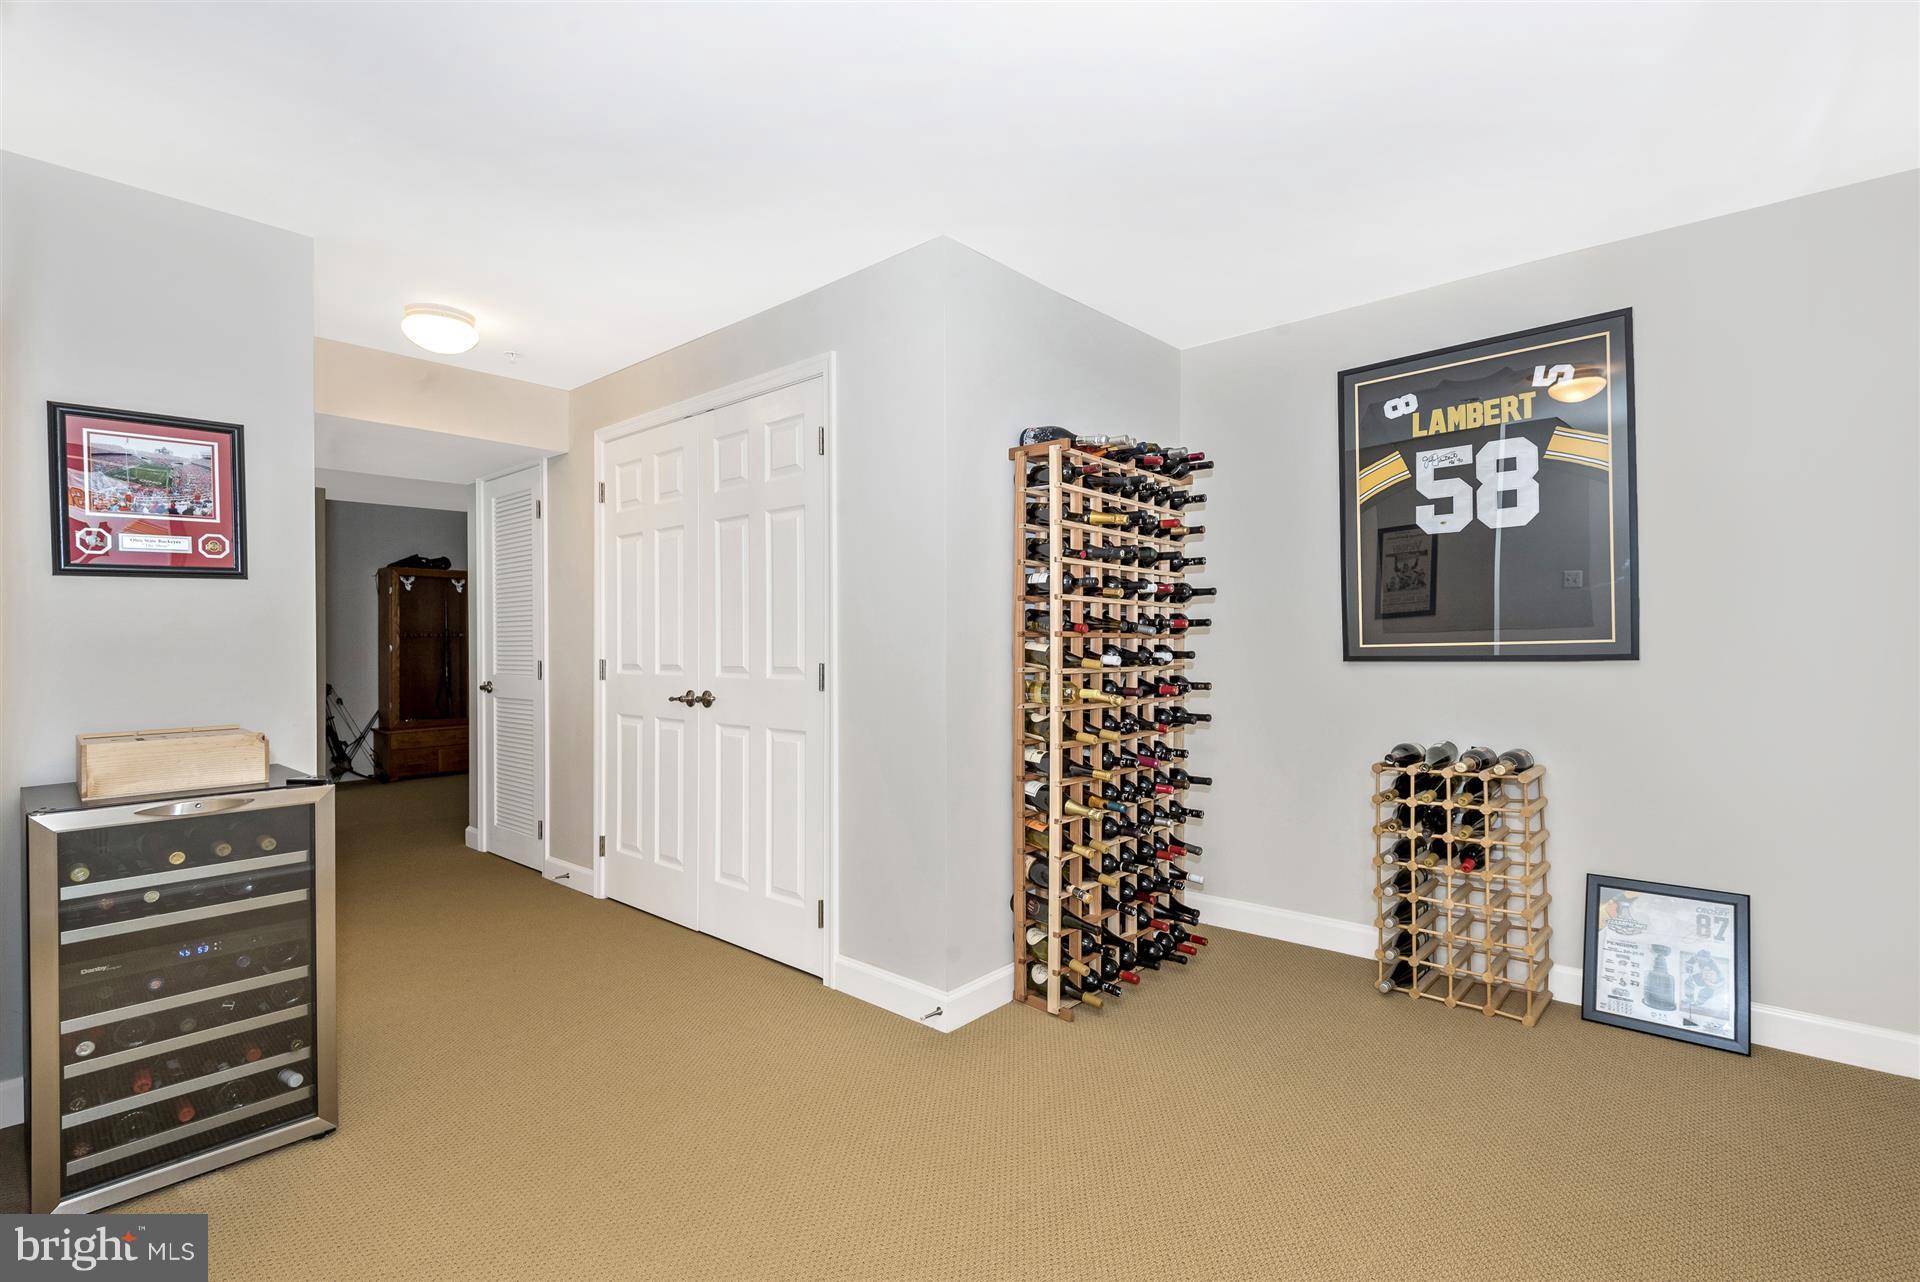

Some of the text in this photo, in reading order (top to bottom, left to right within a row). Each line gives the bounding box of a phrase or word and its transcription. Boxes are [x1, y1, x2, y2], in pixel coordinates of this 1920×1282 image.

[1383, 392, 1419, 420] 8
[1411, 391, 1537, 438] LAMBERT
[1415, 436, 1540, 535] 58
[1695, 906, 1729, 916] CROSBY
[1695, 914, 1729, 942] 87
[80, 965, 107, 975] Danby
